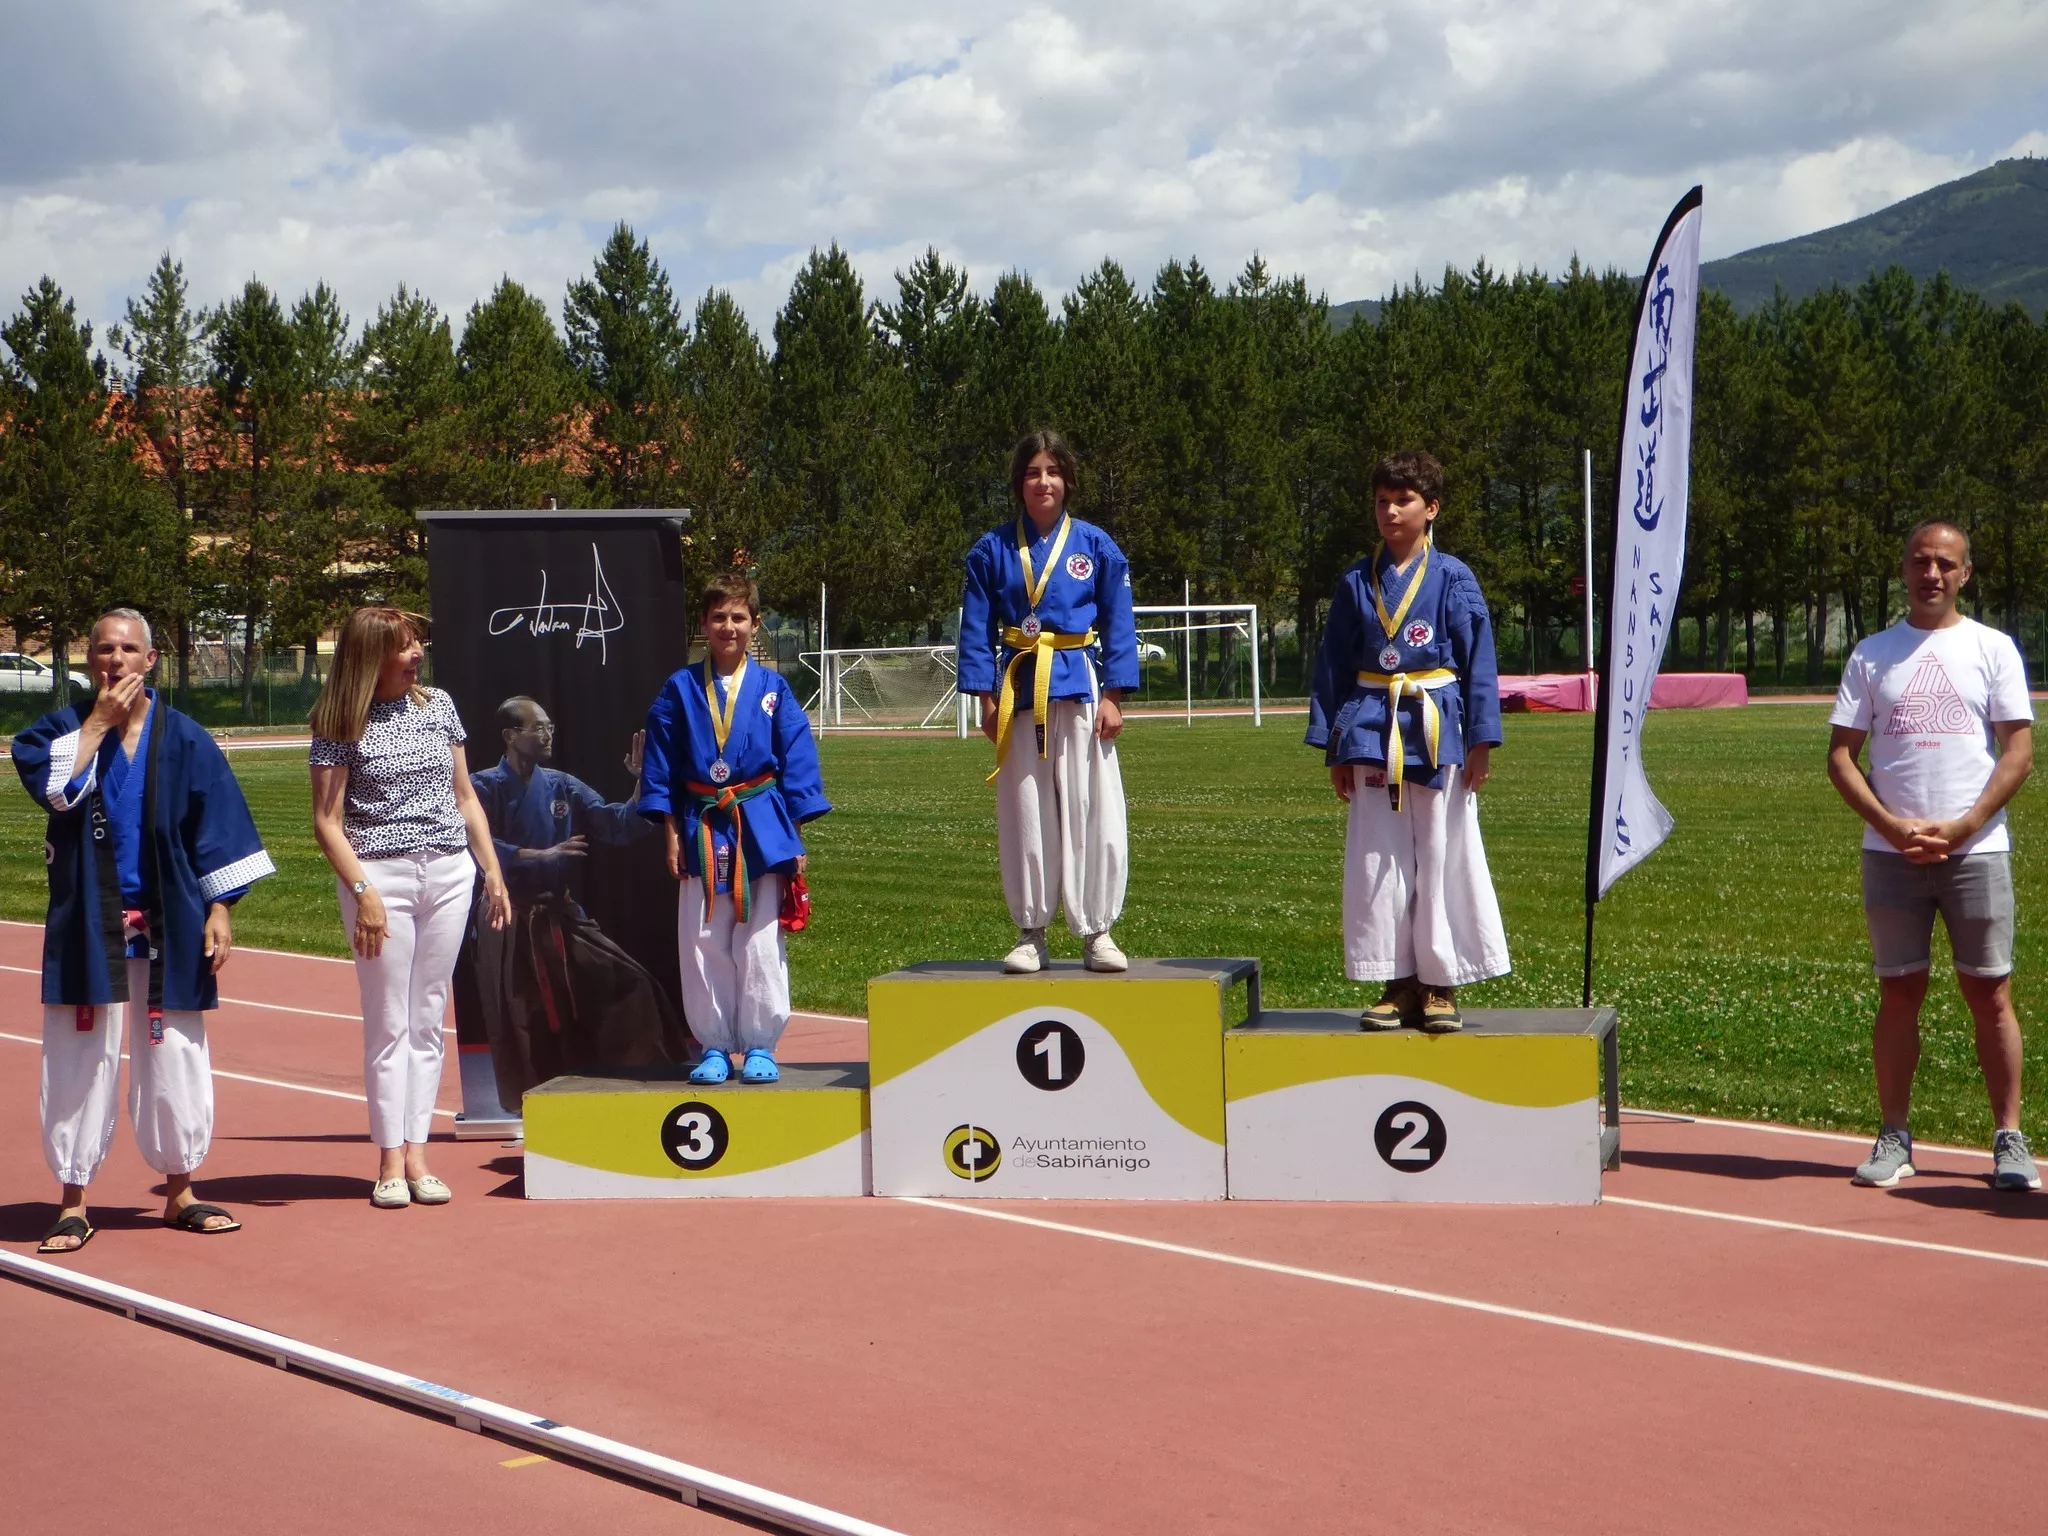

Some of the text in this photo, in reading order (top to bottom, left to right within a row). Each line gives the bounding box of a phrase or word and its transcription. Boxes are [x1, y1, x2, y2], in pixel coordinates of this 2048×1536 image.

[1034, 1031, 1062, 1080] 1
[676, 1112, 714, 1161] 3
[1012, 1136, 1147, 1153] Ayuntamiento
[1390, 1112, 1431, 1161] 2
